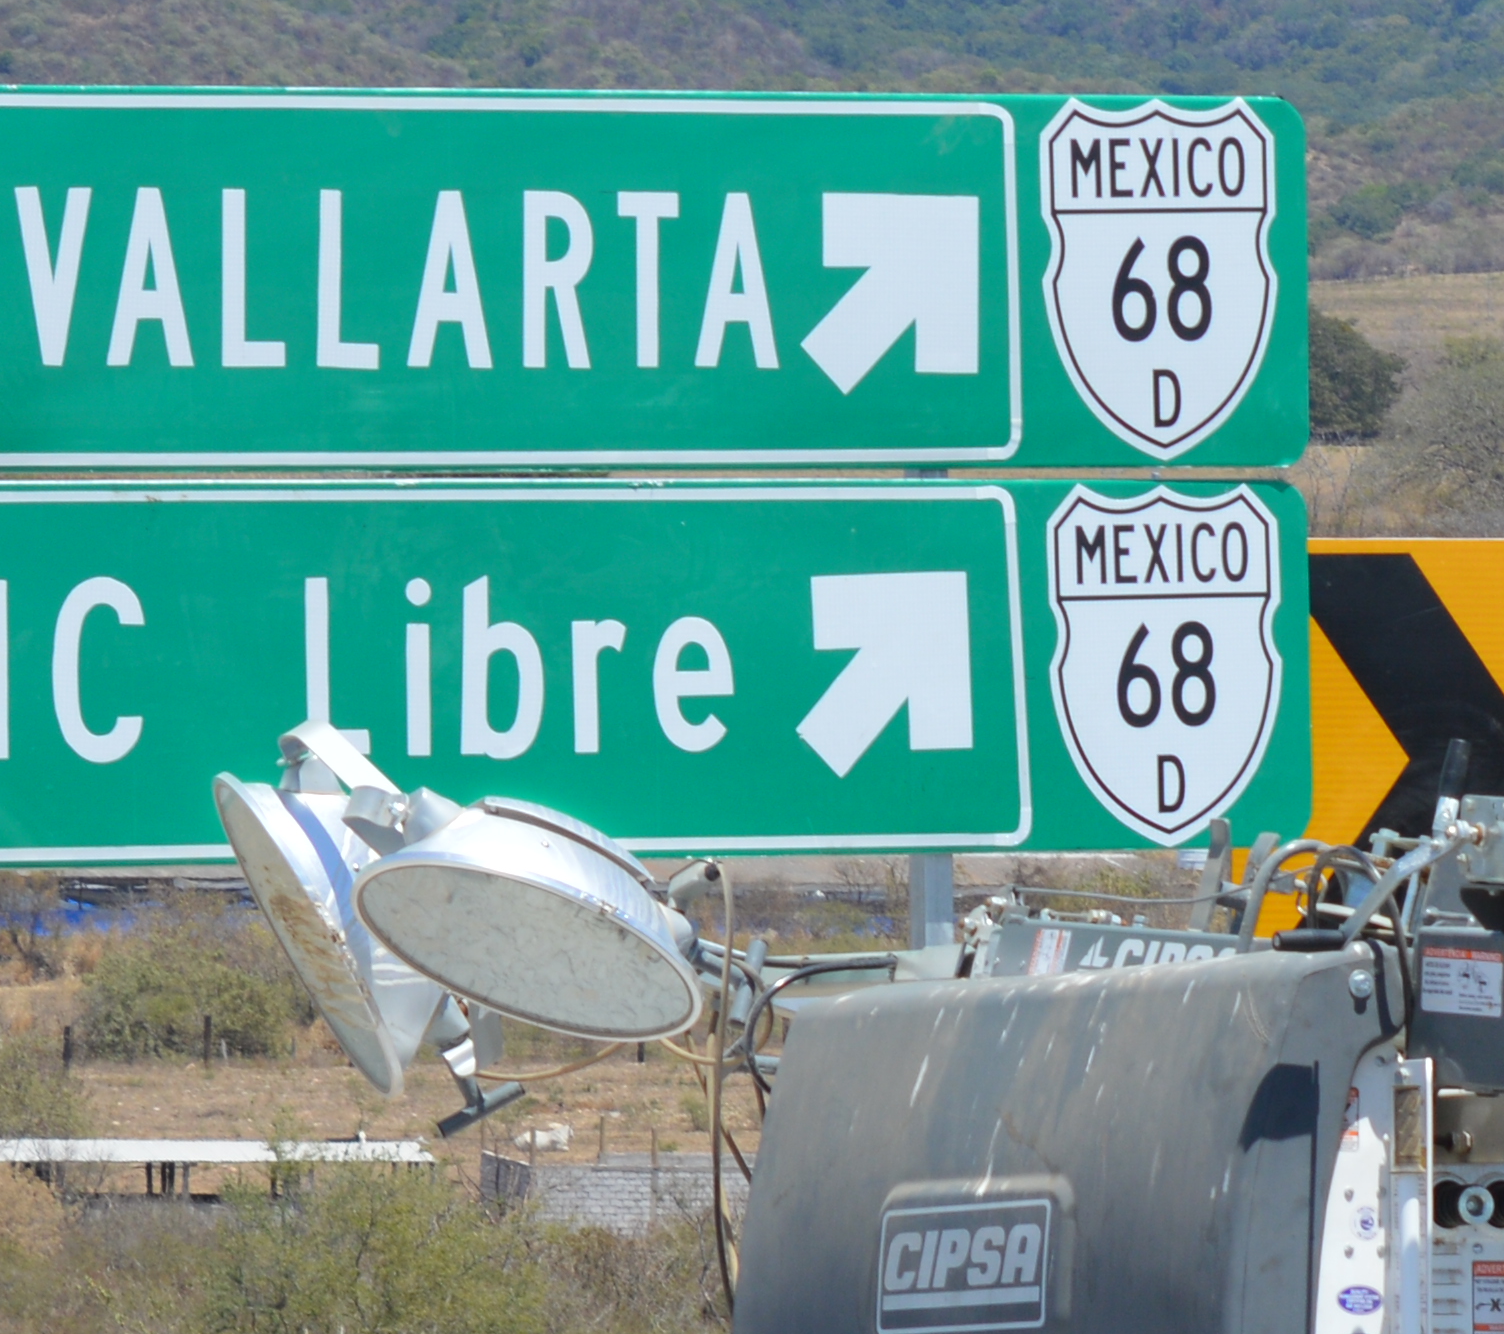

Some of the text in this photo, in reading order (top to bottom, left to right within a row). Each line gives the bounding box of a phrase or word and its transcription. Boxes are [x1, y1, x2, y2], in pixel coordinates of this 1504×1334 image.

[1069, 134, 1247, 200] MEXICO
[14, 185, 781, 370] VALLARTA
[1111, 234, 1214, 344] 68
[1152, 367, 1182, 429] D
[1074, 521, 1250, 587] MEXICO
[304, 575, 735, 760] Libre
[1115, 620, 1217, 730] 68
[1156, 753, 1187, 815] D
[884, 1223, 1042, 1292] CIPSA
